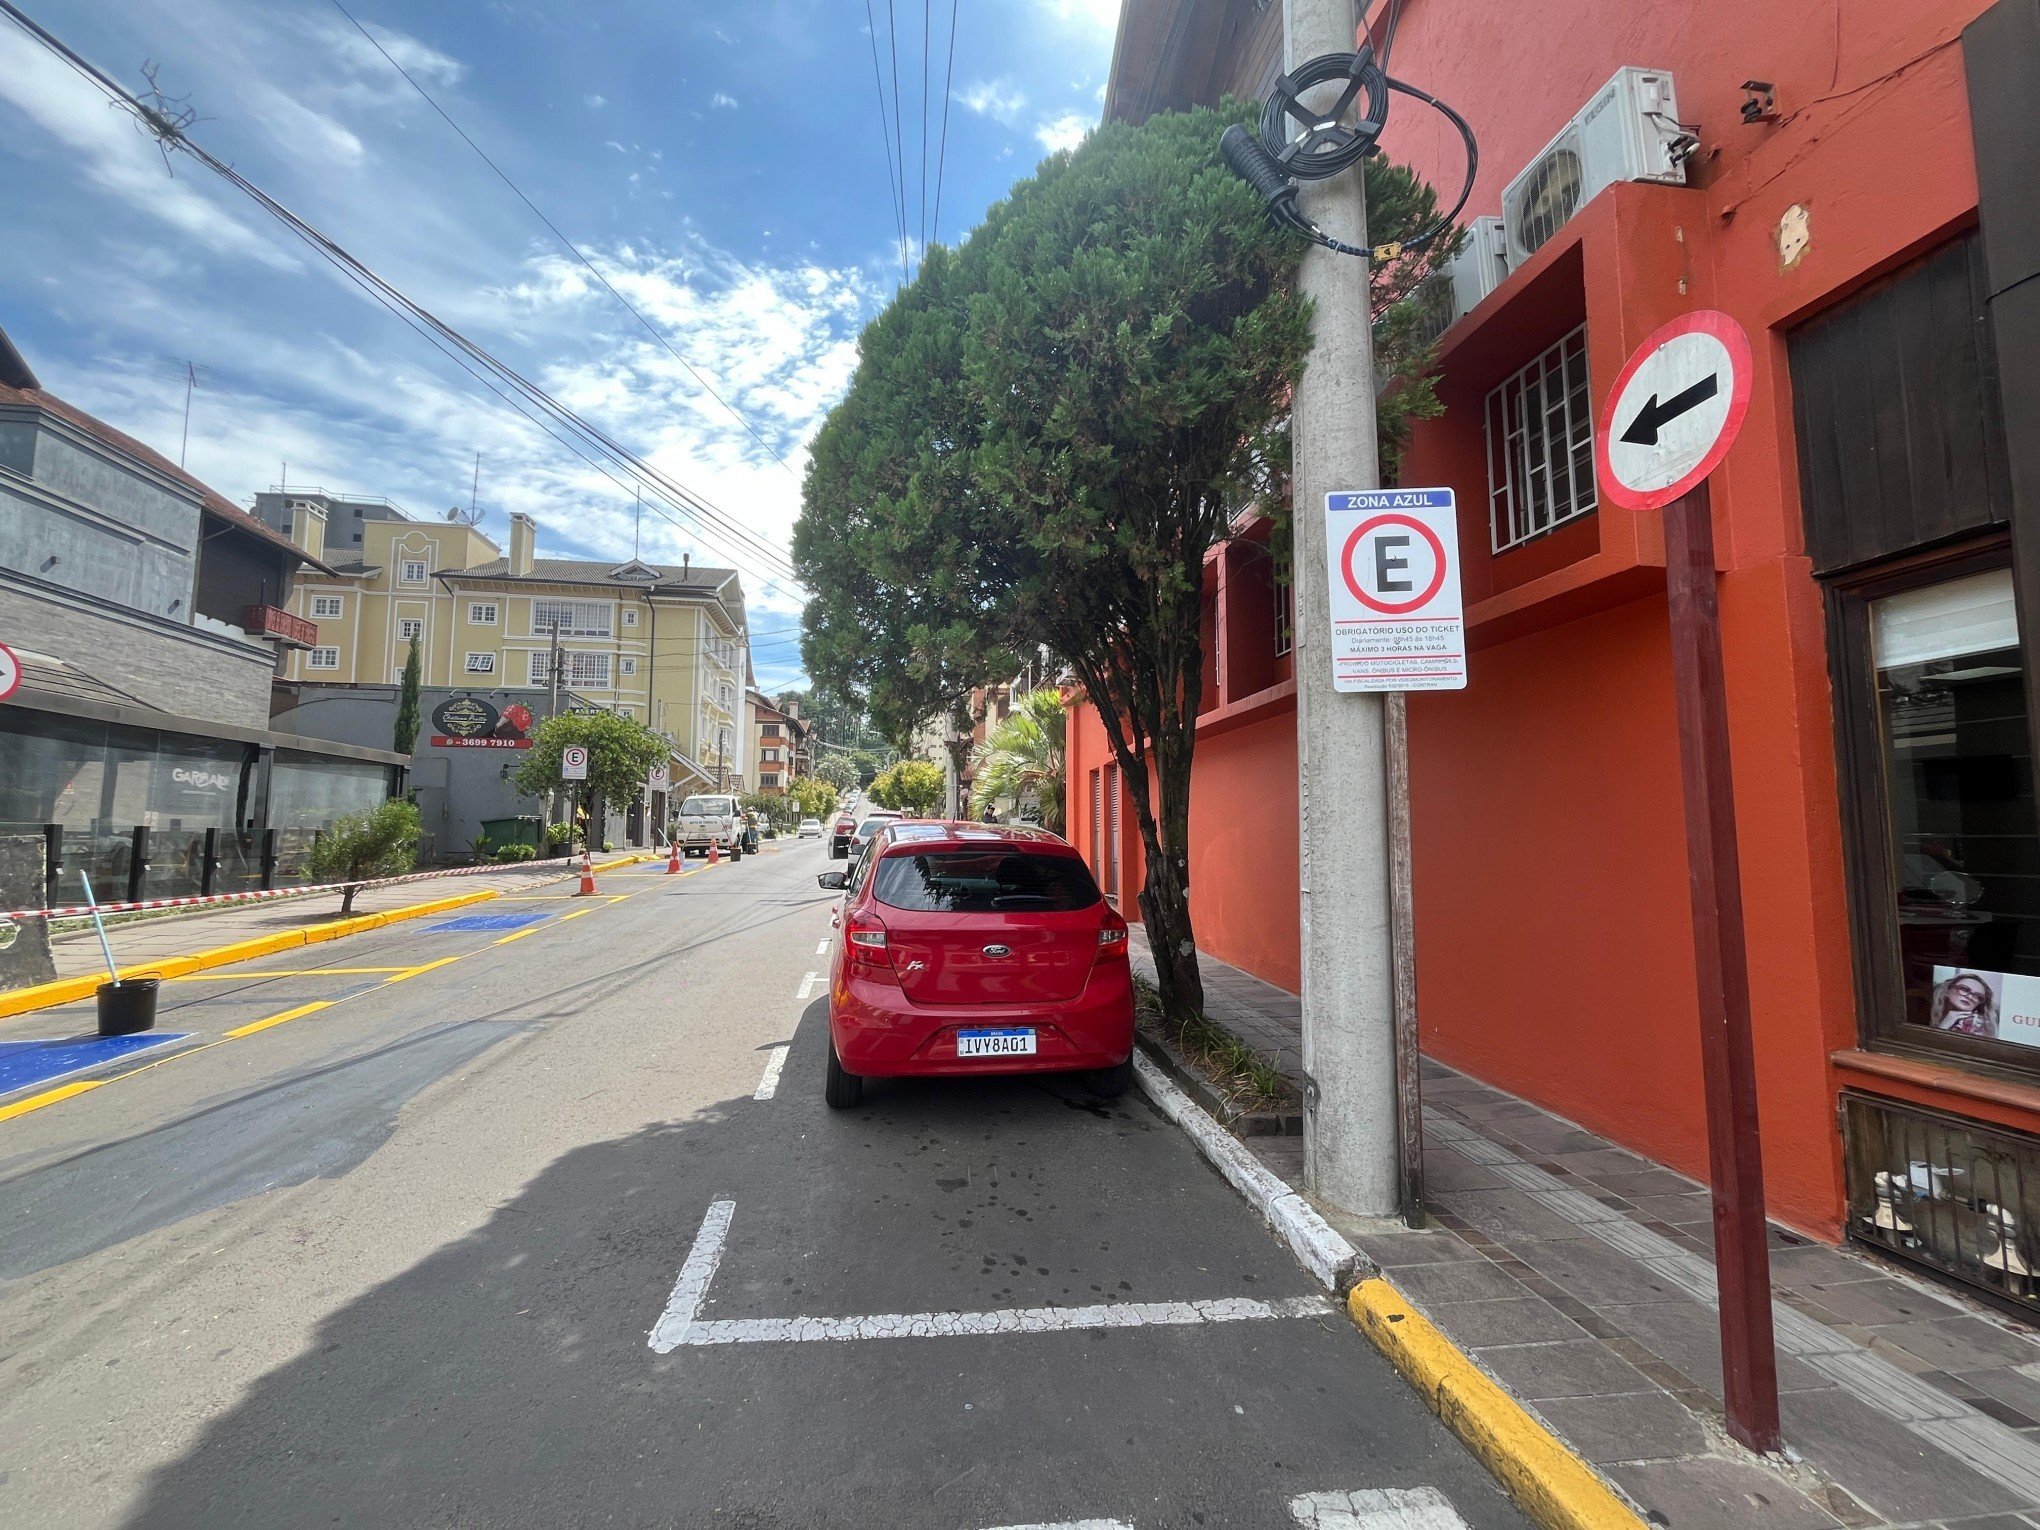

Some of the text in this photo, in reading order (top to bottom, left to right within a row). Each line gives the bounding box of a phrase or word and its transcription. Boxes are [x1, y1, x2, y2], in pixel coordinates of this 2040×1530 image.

[1583, 87, 1616, 126] ELGIN
[1347, 493, 1433, 508] ZONA AZUL
[1374, 535, 1413, 593] E
[1335, 625, 1460, 636] OBRIGATÓRIO USO DO TICKET
[1350, 645, 1380, 653] MÁXIMO
[462, 738, 488, 746] 3699
[490, 739, 515, 747] 7910
[571, 752, 579, 763] E
[964, 1037, 1028, 1054] IVY8A01
